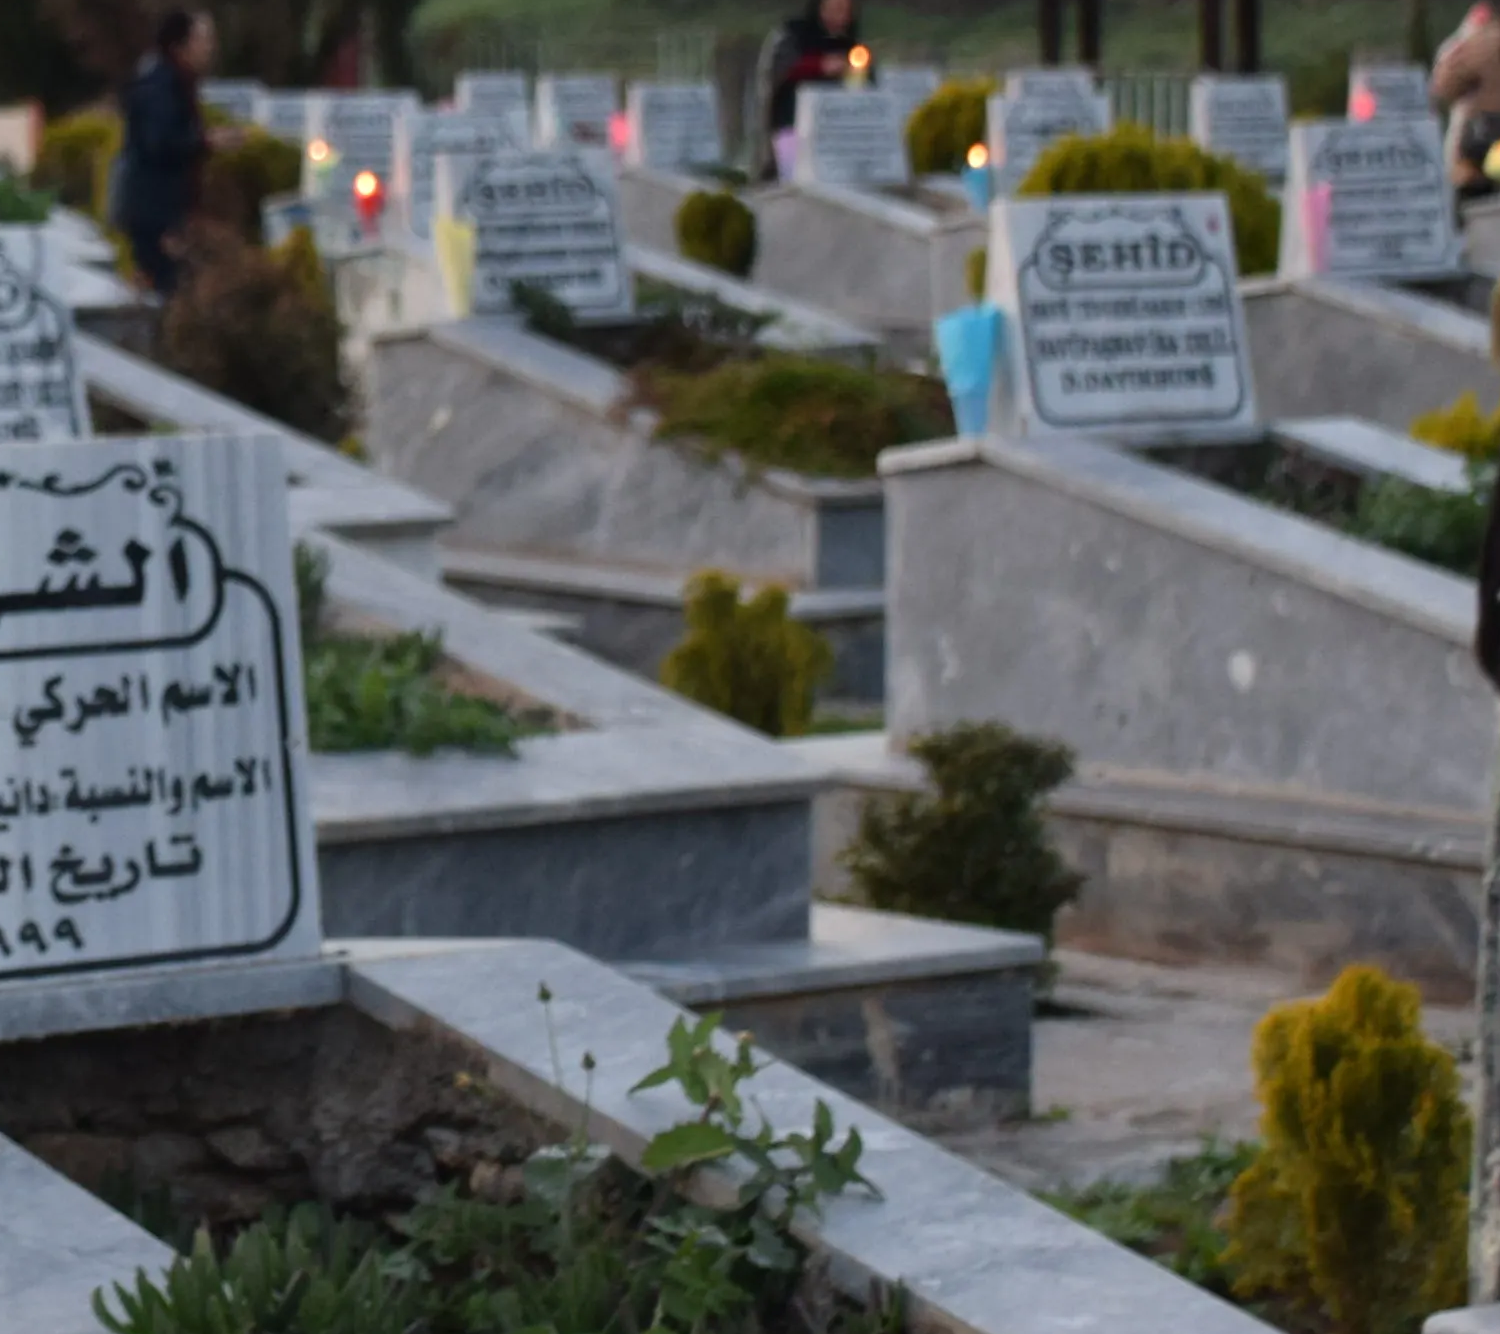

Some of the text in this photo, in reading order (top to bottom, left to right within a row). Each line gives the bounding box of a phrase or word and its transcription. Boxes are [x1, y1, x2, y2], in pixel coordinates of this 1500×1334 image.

[14, 673, 150, 748] الحركي
[161, 662, 257, 728] الاسم
[60, 765, 184, 824] والنسبة
[191, 757, 271, 814] الاسم
[50, 834, 203, 905] تاريخ
